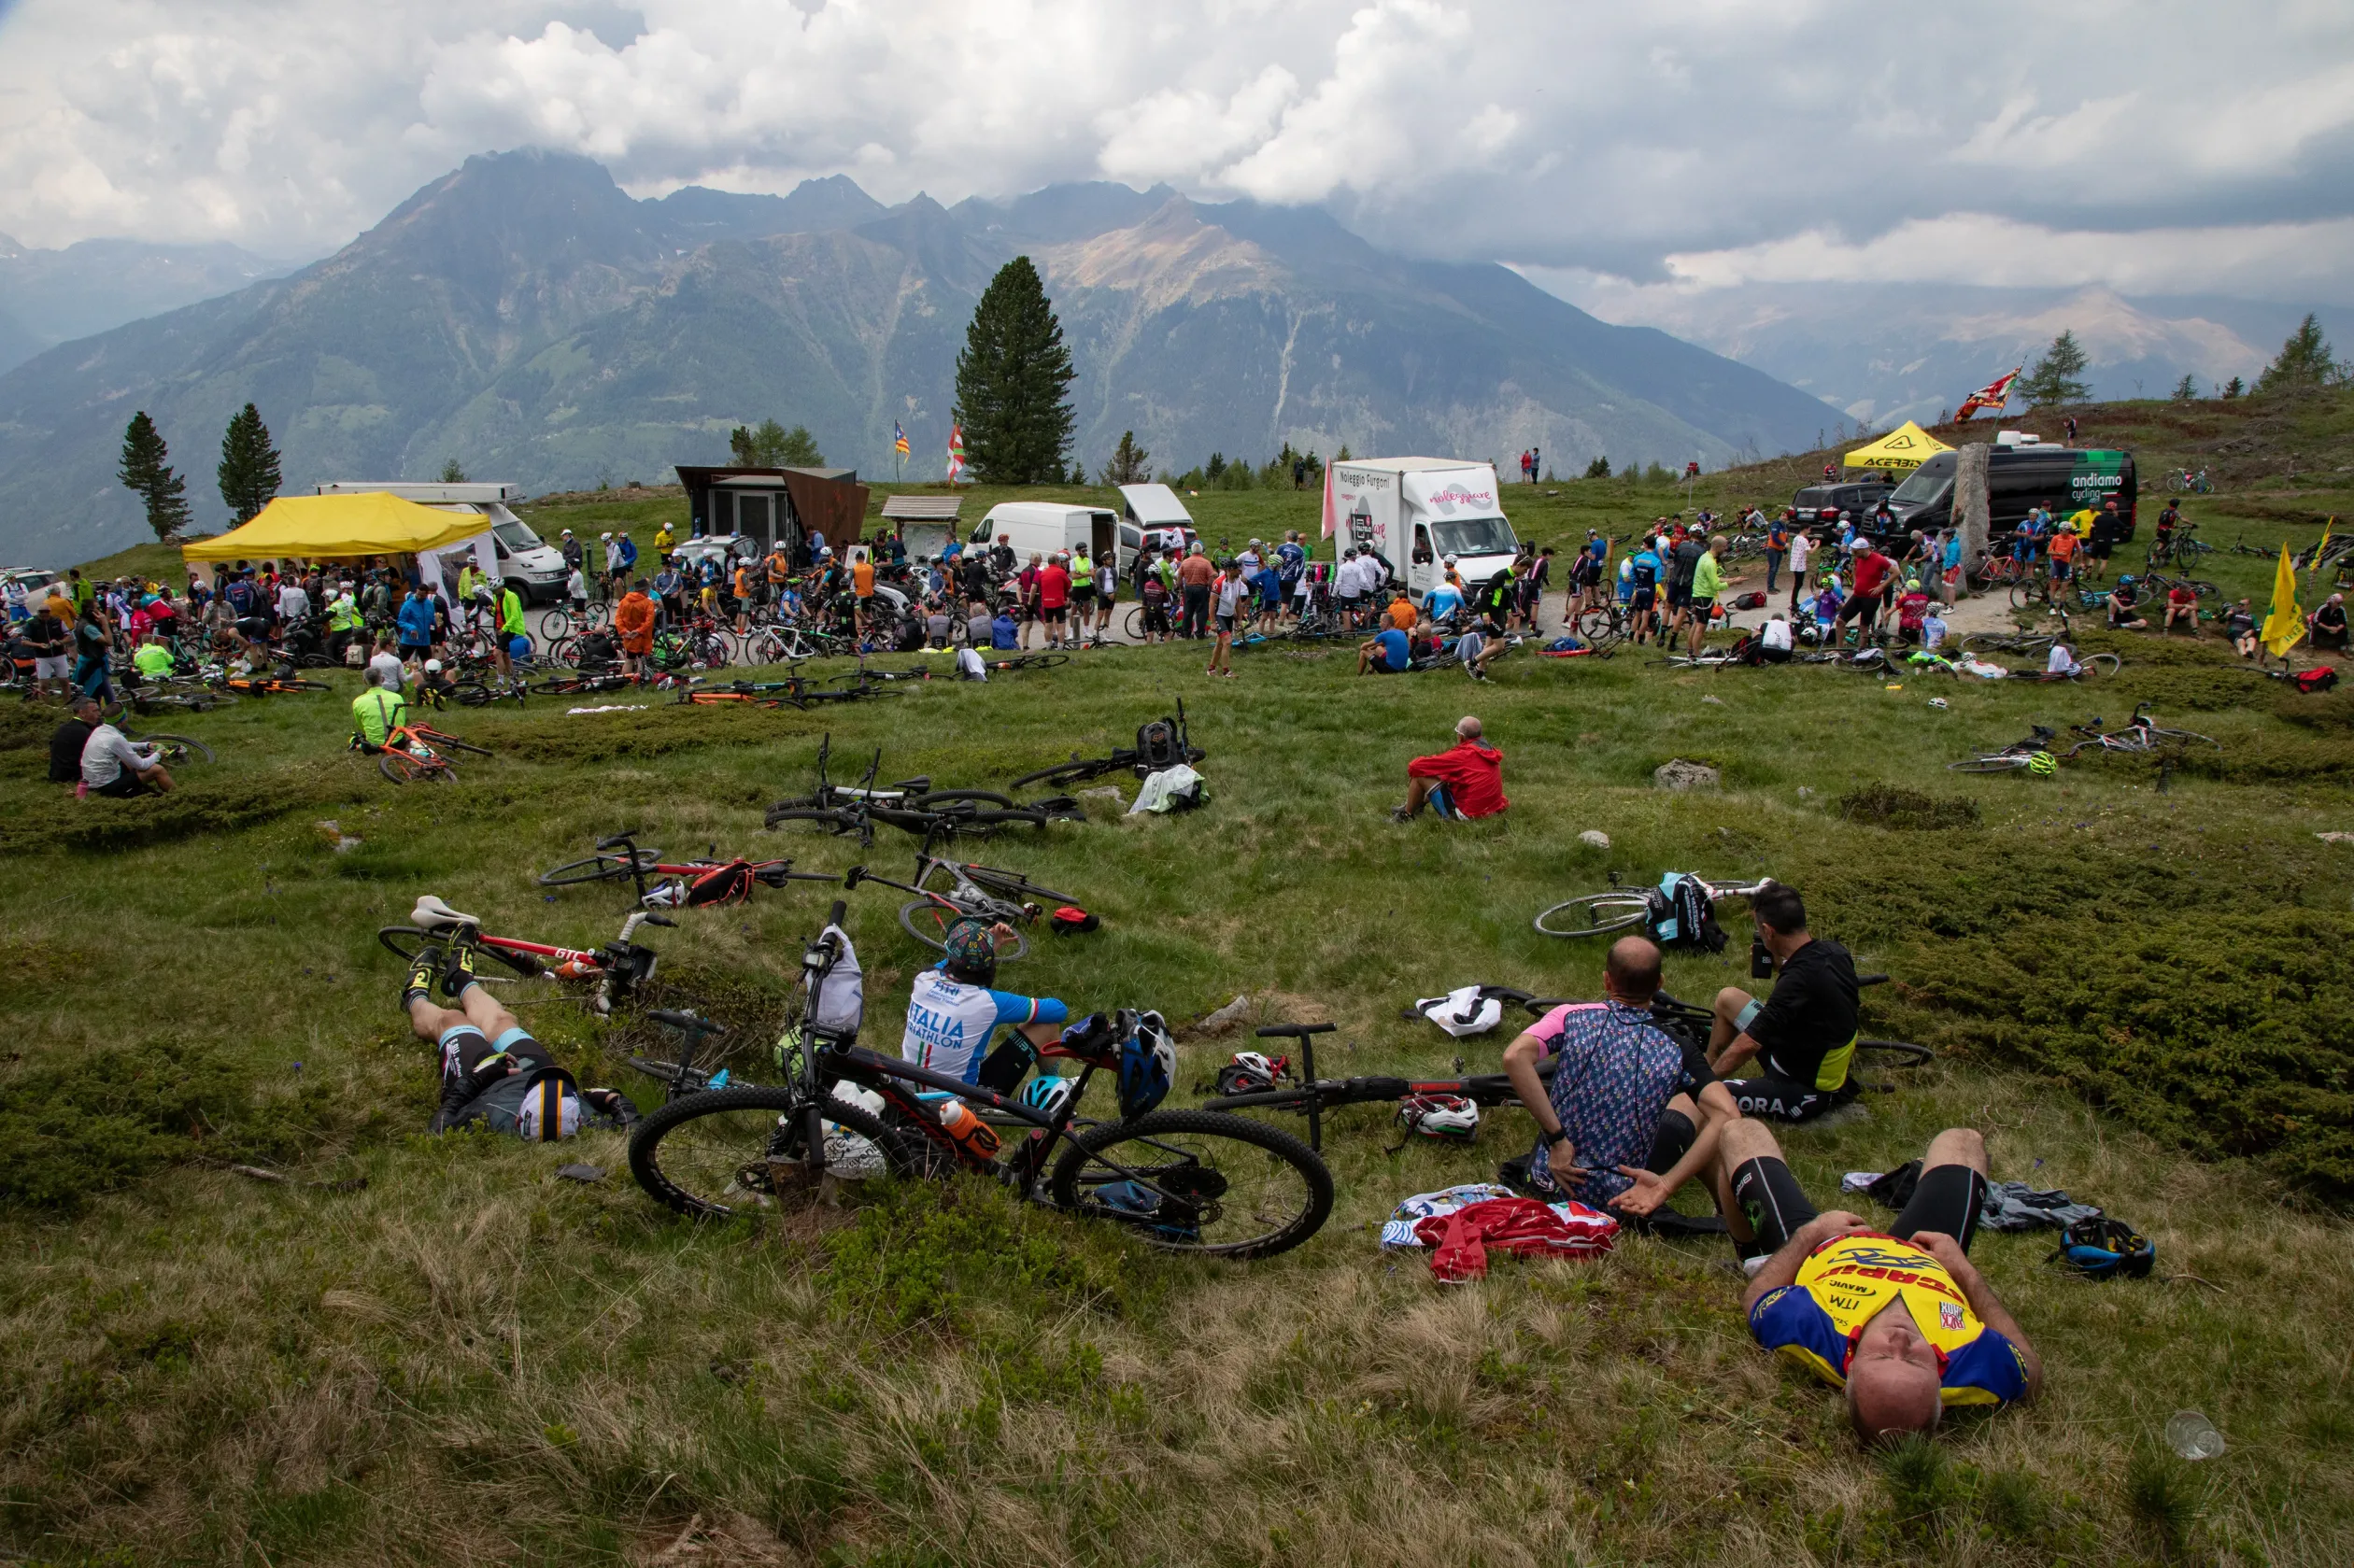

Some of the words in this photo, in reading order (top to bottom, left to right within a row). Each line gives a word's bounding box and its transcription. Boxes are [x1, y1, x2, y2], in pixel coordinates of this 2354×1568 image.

[1340, 471, 1366, 487] Noleggio
[1367, 473, 1390, 490] Furgoni
[2072, 473, 2122, 487] andiamo
[1429, 489, 1492, 505] noleggiare
[2072, 487, 2101, 501] cycling
[555, 948, 585, 962] GTC
[910, 1000, 964, 1039] ITALIA
[1733, 1095, 1786, 1115] ORA
[1828, 1279, 1868, 1293] MAVIC
[1828, 1294, 1860, 1310] ITM
